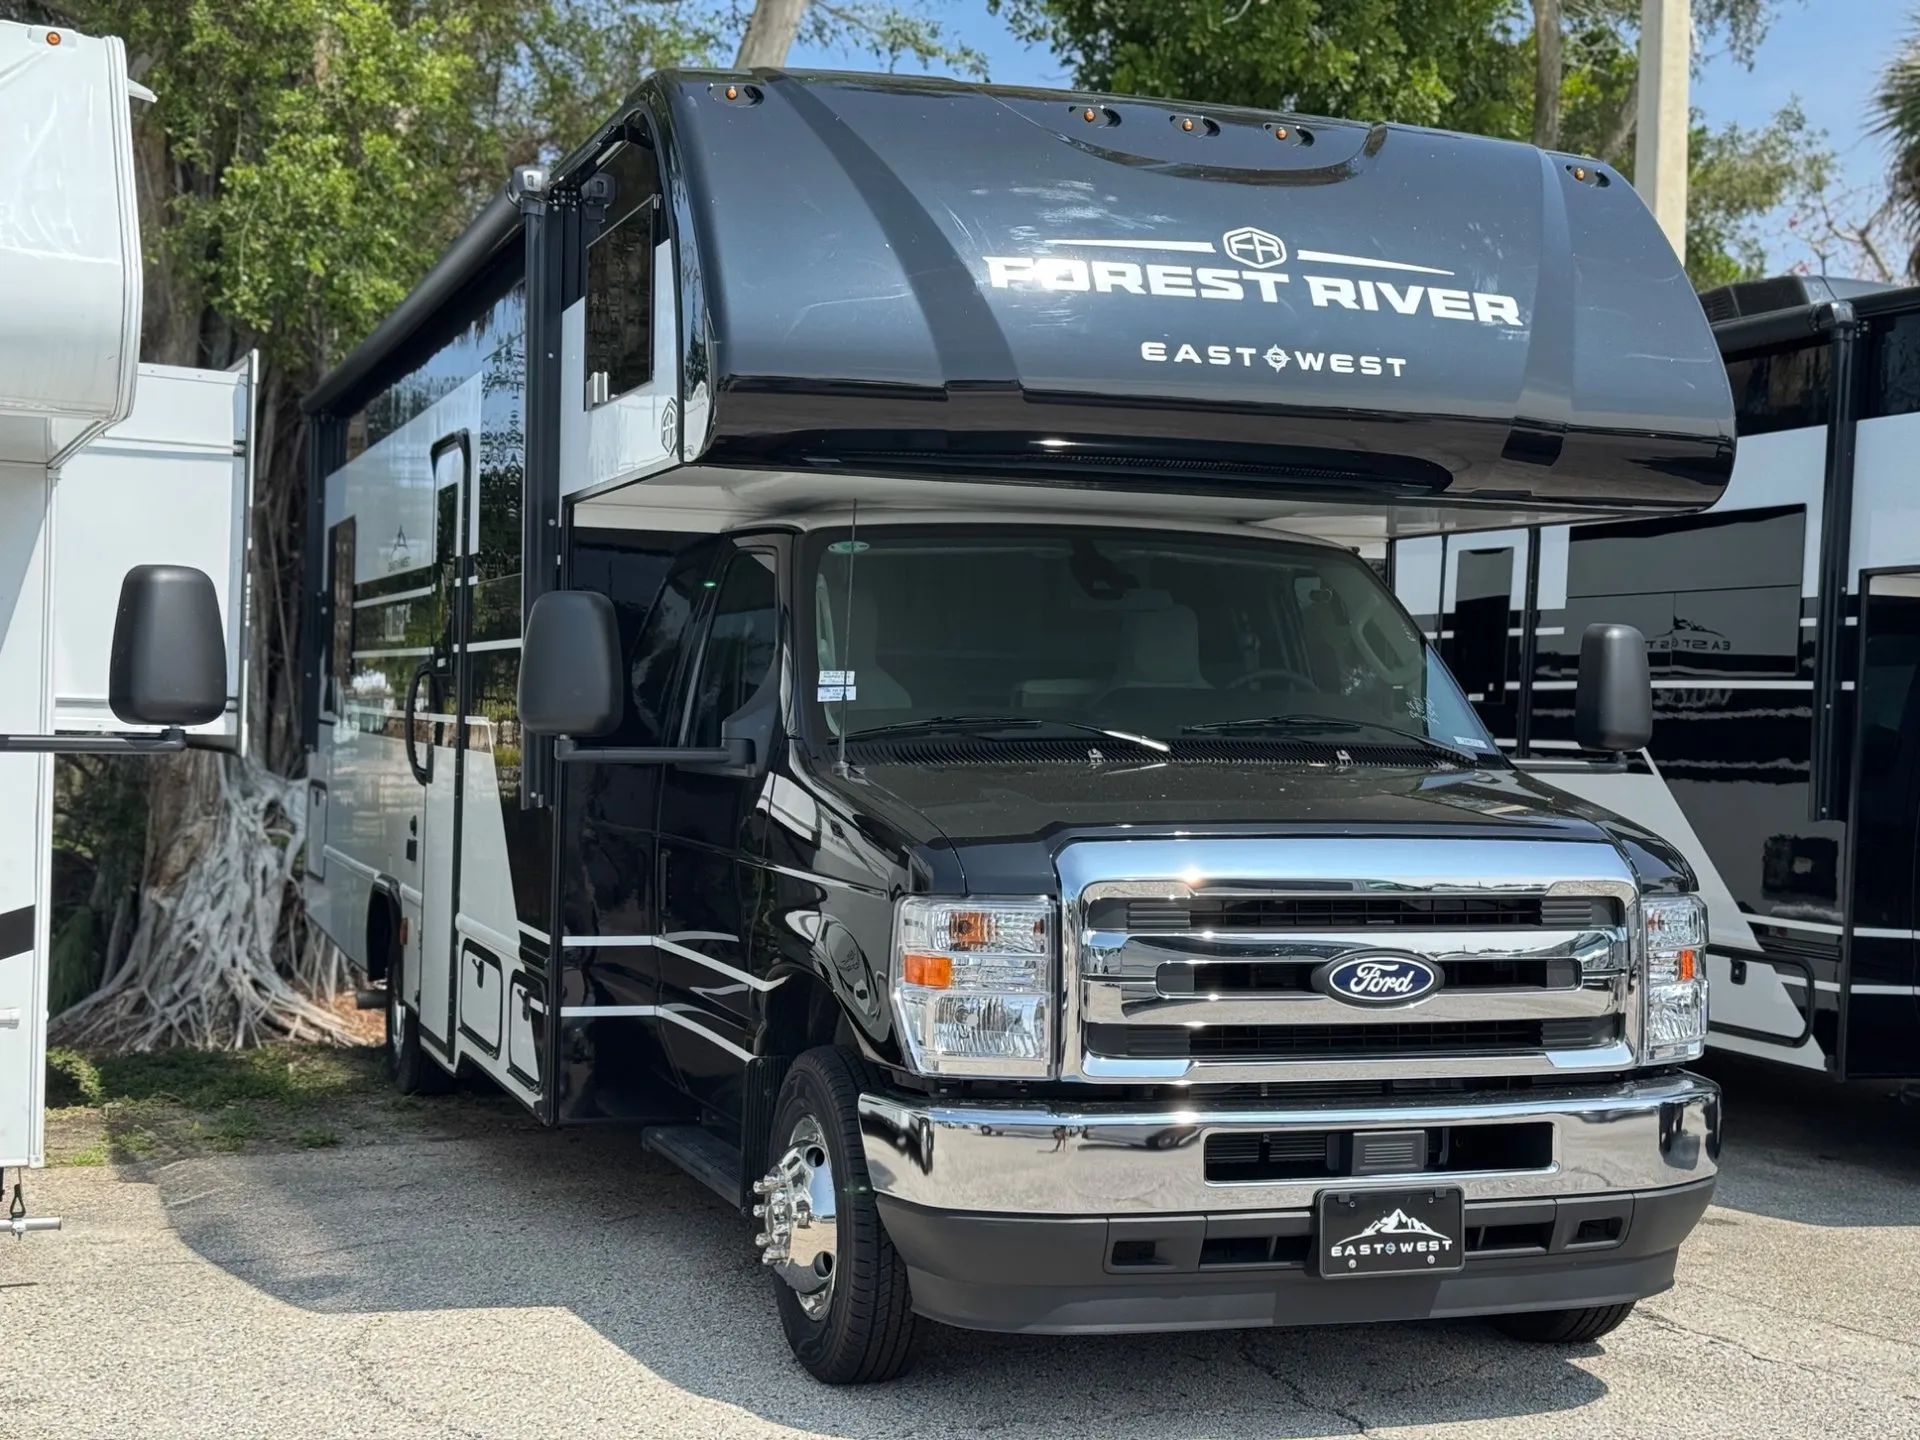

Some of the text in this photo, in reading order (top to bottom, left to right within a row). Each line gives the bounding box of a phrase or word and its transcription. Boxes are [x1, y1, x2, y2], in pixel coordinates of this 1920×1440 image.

[982, 255, 1524, 326] FOREST RIVER
[1140, 341, 1257, 367] EAST
[1294, 351, 1407, 377] WEST
[1350, 962, 1414, 993] Ford
[1331, 1239, 1453, 1258] EAST WEST
